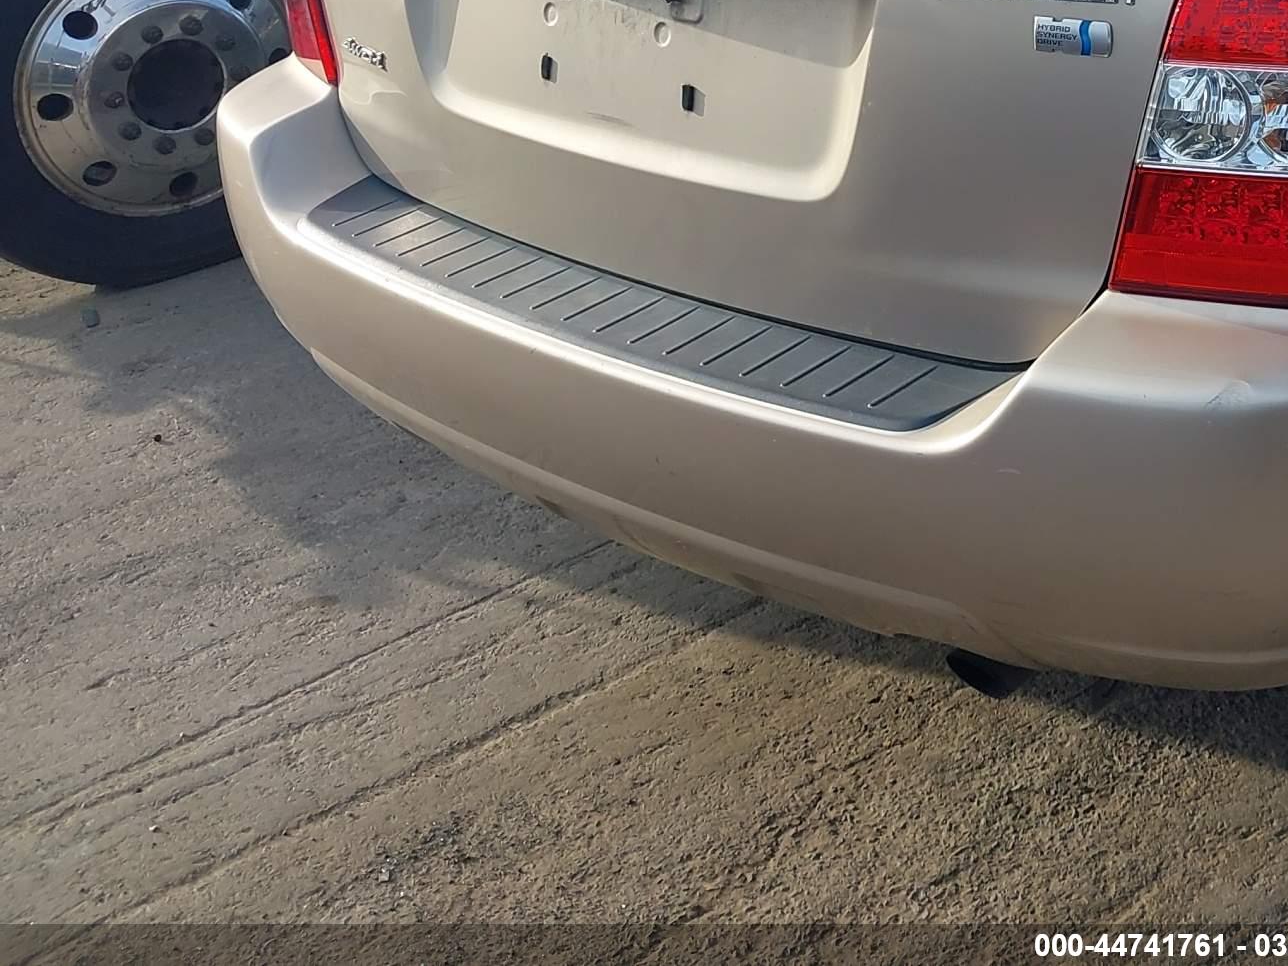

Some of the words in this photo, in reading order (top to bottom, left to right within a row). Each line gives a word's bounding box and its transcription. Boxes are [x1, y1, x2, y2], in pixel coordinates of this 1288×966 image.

[1037, 24, 1071, 33] HYBRID
[1036, 32, 1078, 41] SYNERGY
[1037, 39, 1063, 47] DRIVE
